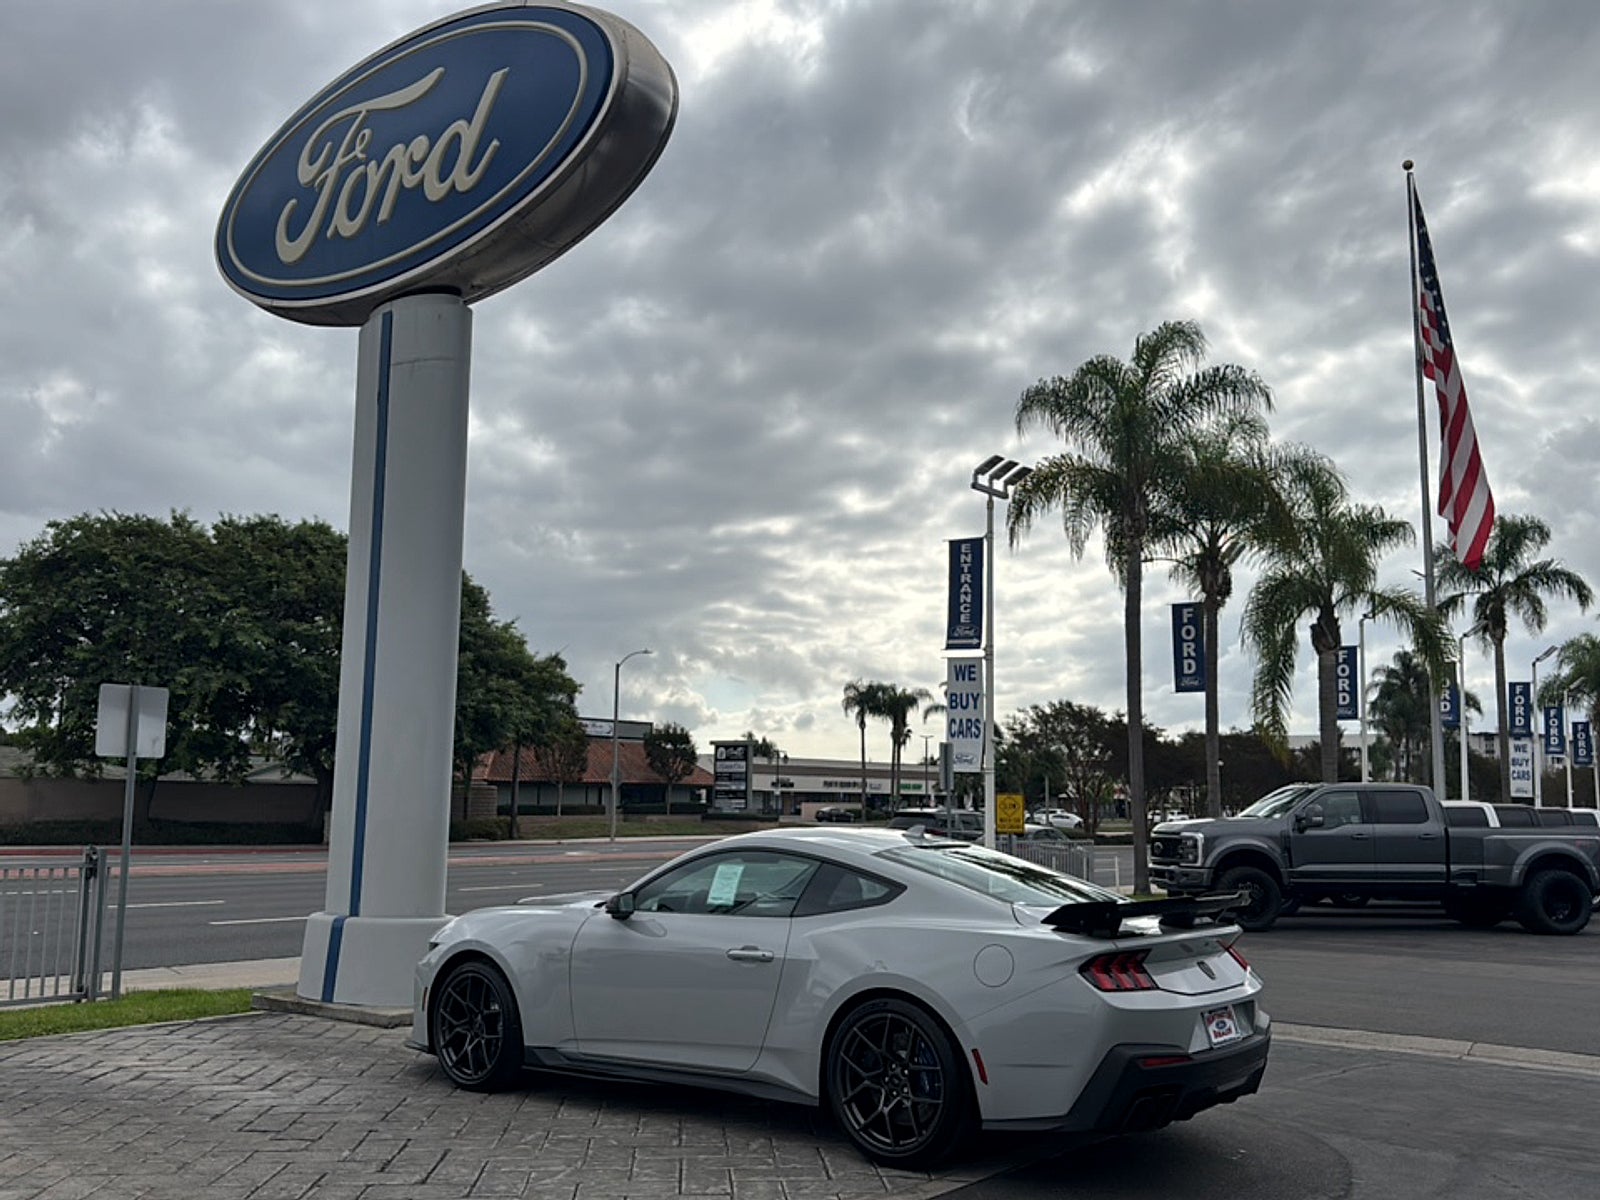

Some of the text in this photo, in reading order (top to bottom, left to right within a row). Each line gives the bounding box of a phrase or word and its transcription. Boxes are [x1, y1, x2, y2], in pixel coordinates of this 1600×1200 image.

[275, 66, 510, 265] Ford
[960, 543, 972, 623] ENTRANCE
[1181, 608, 1196, 674] FORD
[954, 664, 977, 682] WE
[1337, 650, 1350, 705] FORD
[949, 692, 980, 710] BUY
[1514, 685, 1525, 727] FORD
[949, 720, 981, 739] CARS
[1549, 709, 1558, 745] FORD
[1511, 757, 1530, 767] BUY
[1513, 744, 1528, 753] WE
[1511, 769, 1531, 781] CARS
